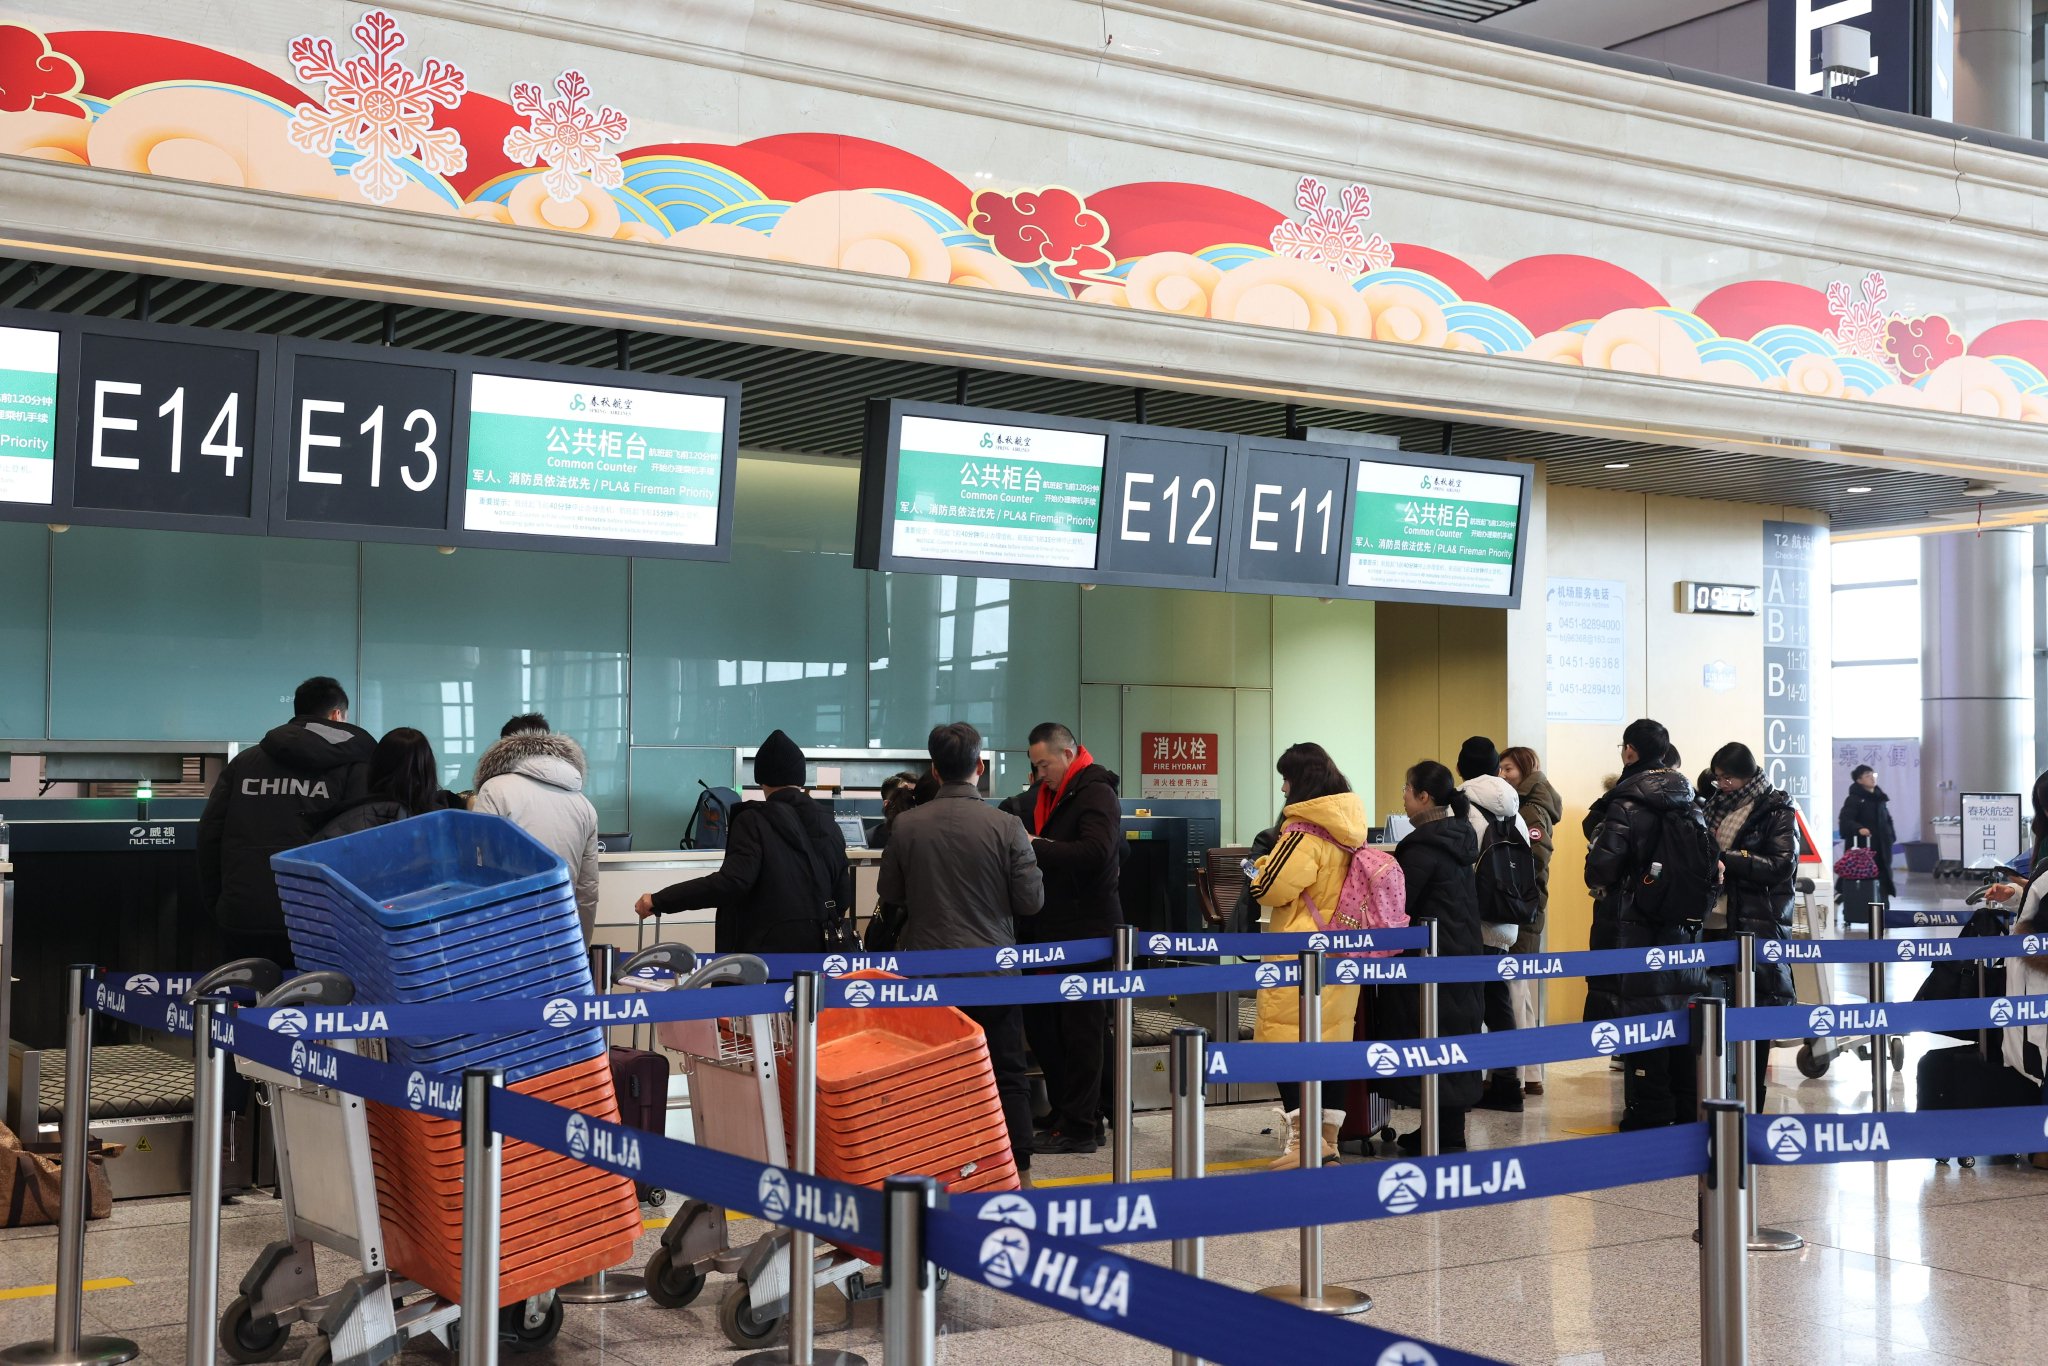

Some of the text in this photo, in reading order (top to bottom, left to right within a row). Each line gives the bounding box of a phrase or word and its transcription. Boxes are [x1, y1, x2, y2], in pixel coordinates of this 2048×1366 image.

[0, 393, 53, 407] 前120分钟
[591, 395, 633, 409] 春秋航空
[92, 380, 244, 477] E14
[1, 434, 48, 452] Priority
[299, 399, 438, 492] E13
[546, 426, 648, 460] 公共柜台
[996, 434, 1032, 447] 春秋航空
[547, 456, 638, 474] Common Counter
[472, 469, 591, 491] 军人、消防员依法优先
[601, 480, 631, 492] PLA&
[634, 483, 675, 496] Fireman
[680, 486, 715, 500] Priority
[960, 461, 1042, 493] 公共柜台
[960, 490, 1034, 505] Common Counter
[1121, 471, 1216, 546] E12
[900, 501, 995, 520] 军人、消防员依法优先
[1004, 510, 1027, 522] PLA&
[1030, 512, 1064, 524] Fireman
[1067, 514, 1096, 528] Priority
[1250, 483, 1333, 555] E11
[1404, 501, 1470, 529] 公共柜台
[1404, 525, 1463, 539] Common Counter
[1774, 533, 1789, 547] T2
[1355, 536, 1431, 554] 军人、消防员依法优先
[1438, 544, 1456, 554] PLA&
[1459, 545, 1487, 556] Fireman
[1488, 548, 1512, 560] Priority
[1557, 586, 1610, 600] 机场服务电话
[1767, 569, 1785, 603] A
[1558, 617, 1621, 631] 0451-82894000
[1768, 608, 1785, 642] B
[1559, 655, 1620, 669] 0451-96368
[1768, 650, 1807, 697] B 11-12
[1559, 683, 1621, 695] 0451-82894120
[1787, 683, 1807, 702] 14-20
[1769, 719, 1806, 754] C 1-10
[1153, 736, 1207, 760] 消火栓
[1171, 763, 1207, 771] HYDRANT
[1769, 758, 1808, 794] C 11-20
[241, 778, 330, 799] CHINA
[1153, 778, 1208, 787] 消火栓使用方法
[1968, 805, 2014, 816] 春秋航空
[149, 827, 176, 838] 威视
[1982, 824, 1996, 851] 出口
[1930, 914, 1958, 924] HLJA
[1174, 937, 1219, 952] HLJA
[1334, 933, 1374, 948] HLJA
[1786, 944, 1821, 959] HLJA
[1918, 942, 1952, 957] HLJA
[852, 956, 899, 972] HLJA
[1022, 947, 1066, 964] HLJA
[1523, 958, 1563, 975] HLJA
[1668, 948, 1706, 965] HLJA
[1363, 963, 1408, 979] HLJA
[880, 983, 938, 1003] HLJA
[1092, 975, 1146, 995] HLJA
[107, 988, 126, 1013] HLJA
[583, 998, 649, 1020] HLJA
[2017, 1000, 2048, 1020] HLJ
[178, 1009, 194, 1031] HLJ
[315, 1011, 389, 1033] HLJA
[1839, 1008, 1889, 1030] HLJA
[211, 1018, 235, 1046] HLJA
[1624, 1019, 1676, 1045] HLJA
[1403, 1043, 1468, 1068] HLJA
[308, 1053, 338, 1081] HLJA
[1814, 1122, 1890, 1153] HLJA
[592, 1130, 641, 1170] HLJA
[1436, 1158, 1526, 1200] HLJA
[795, 1183, 859, 1233] HLJA
[1047, 1194, 1157, 1236] HLJA
[1030, 1247, 1130, 1317] HLJA
